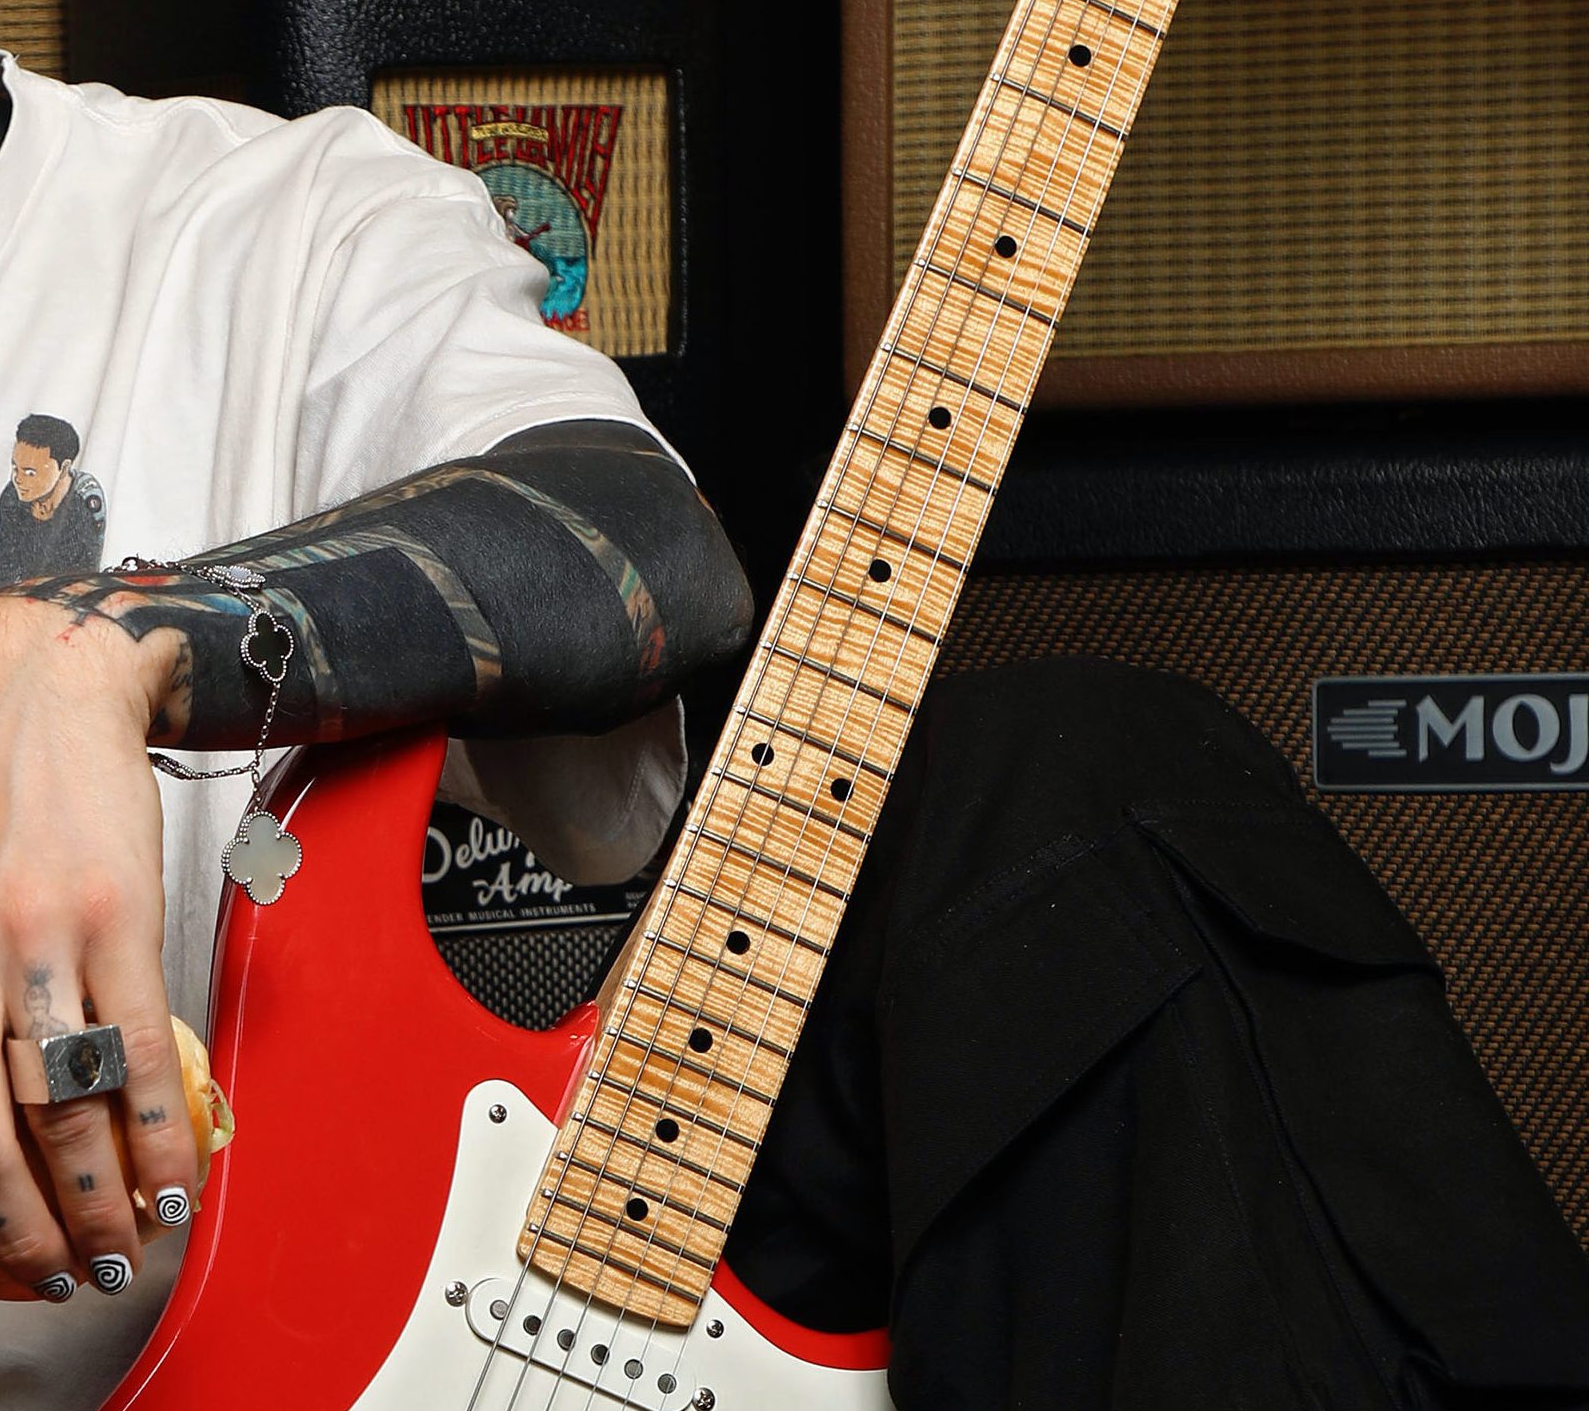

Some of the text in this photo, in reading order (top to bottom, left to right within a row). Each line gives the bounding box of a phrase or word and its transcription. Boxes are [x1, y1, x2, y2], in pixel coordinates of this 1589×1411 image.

[422, 817, 521, 884] Delu
[426, 902, 597, 924] ENDER MUSICAL INSTRUMENTS
